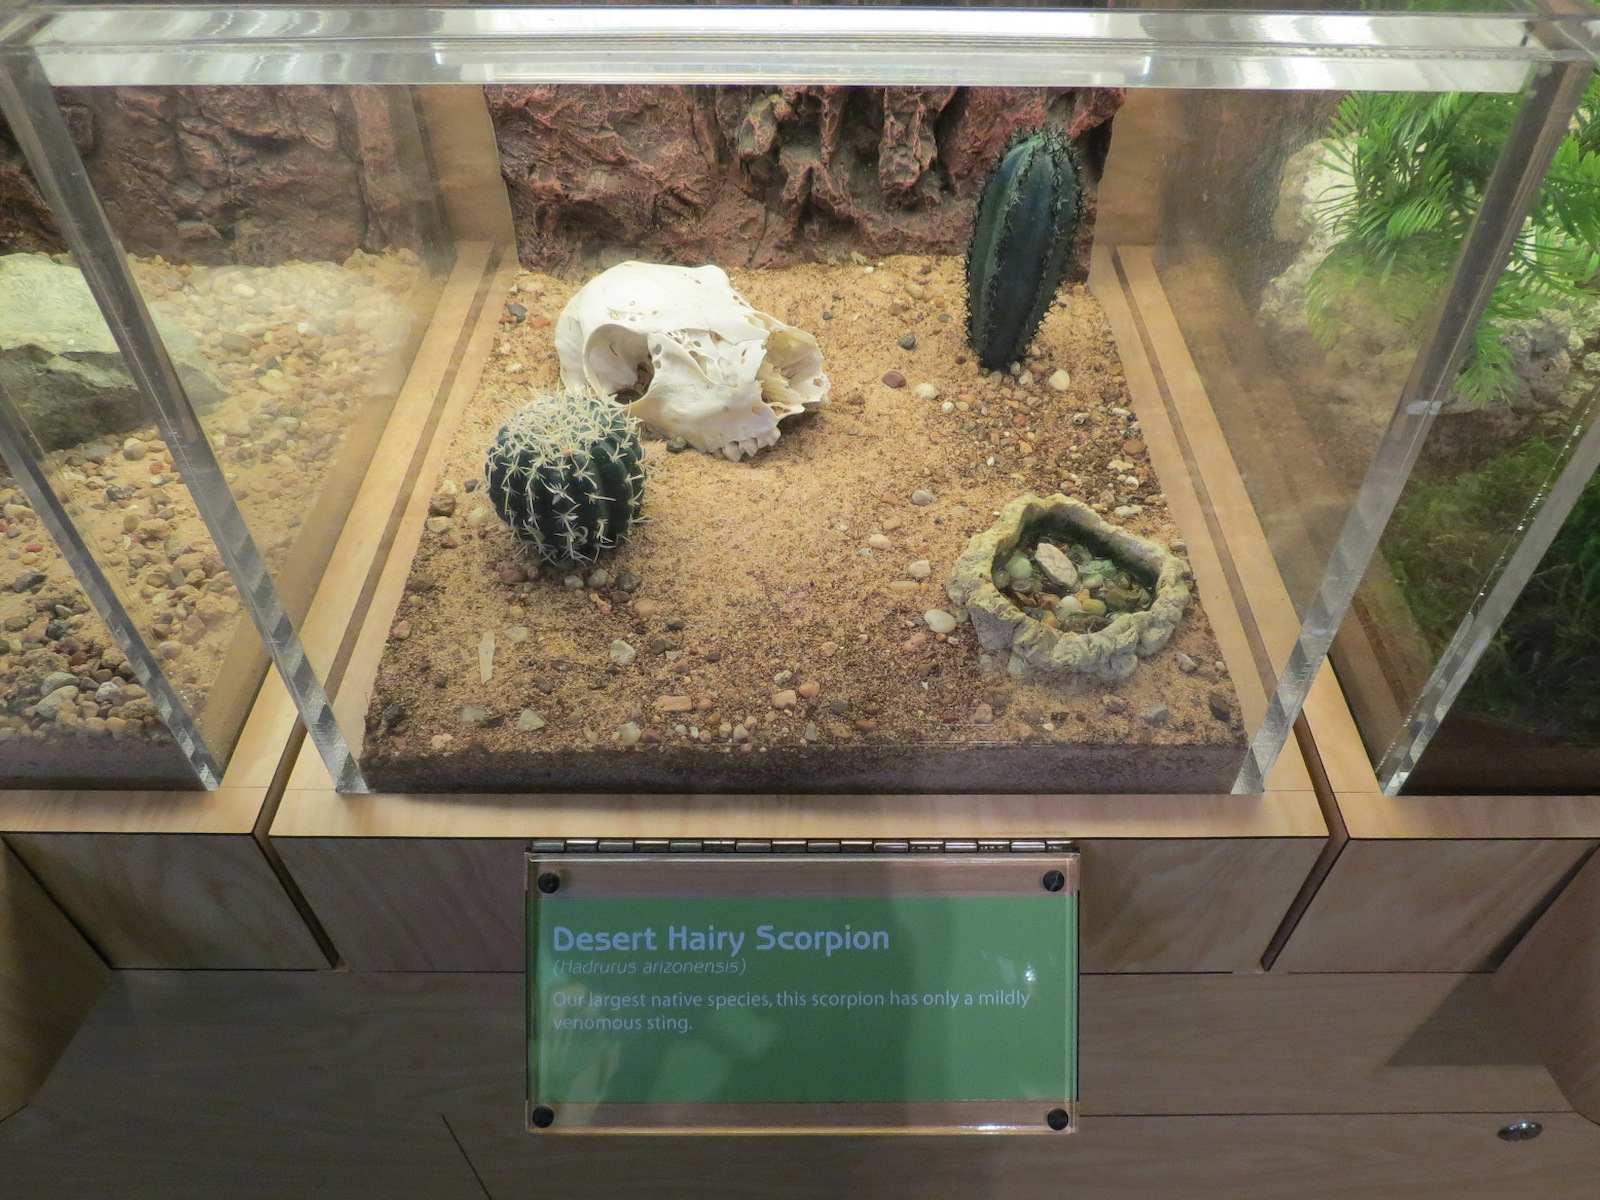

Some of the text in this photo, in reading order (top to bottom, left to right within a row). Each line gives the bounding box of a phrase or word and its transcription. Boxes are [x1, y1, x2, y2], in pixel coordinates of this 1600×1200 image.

[554, 924, 889, 957] Desert Hairy Scorpion
[554, 958, 747, 977] (Hadrurus arizonensis)
[554, 988, 1030, 1010] Our largest native species, this scorpion has only a mildly
[554, 1014, 693, 1034] venomous sting.
